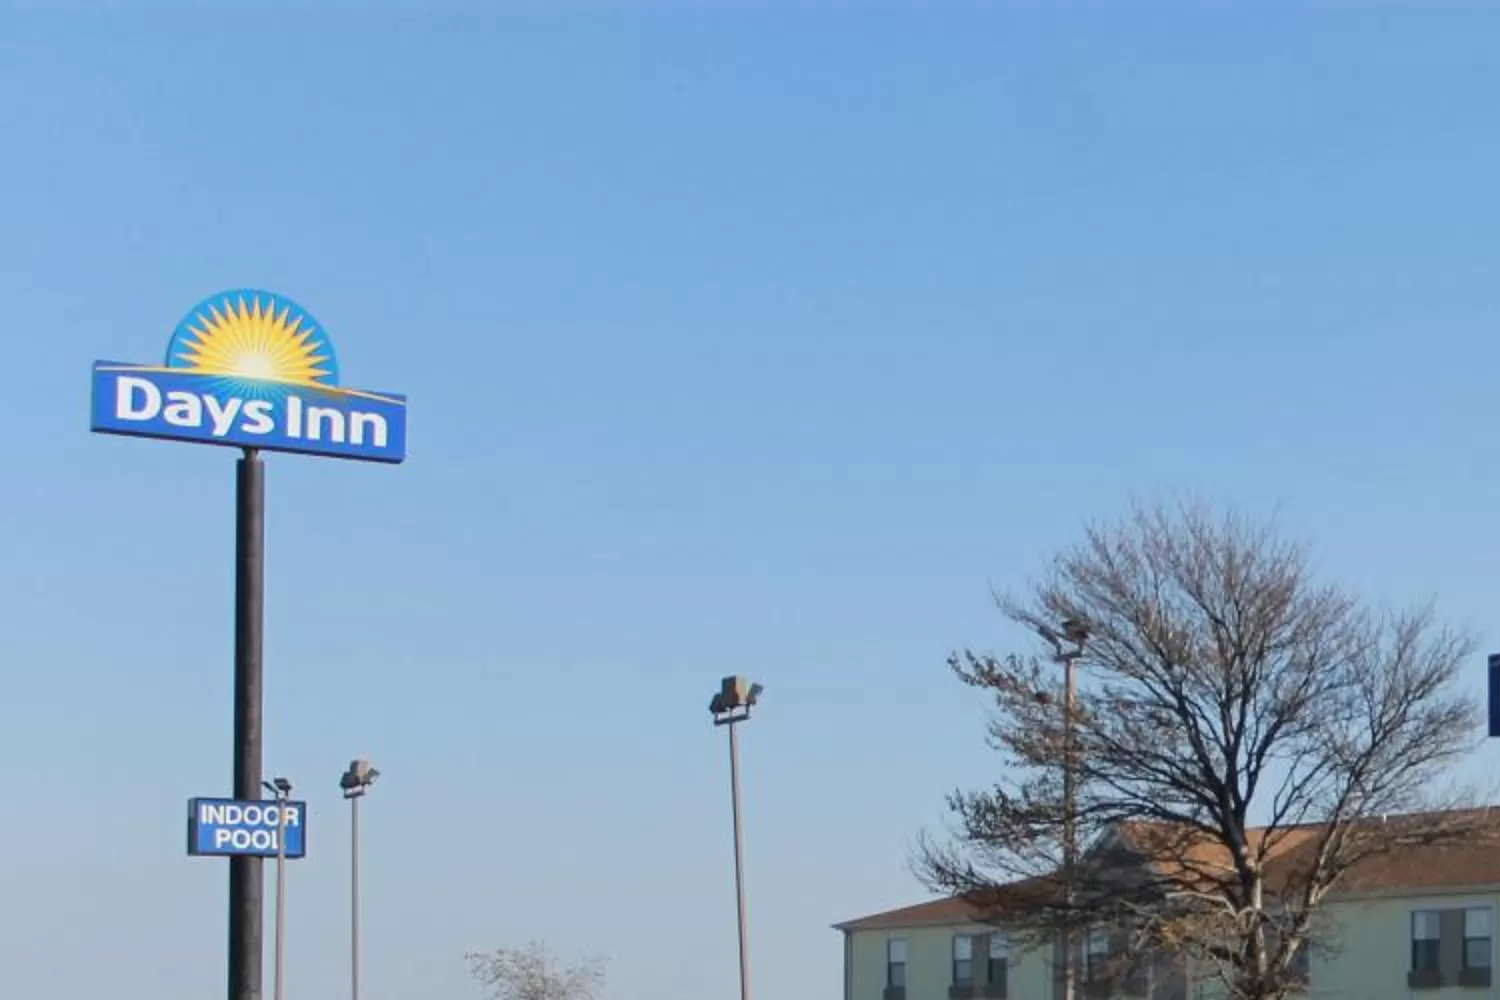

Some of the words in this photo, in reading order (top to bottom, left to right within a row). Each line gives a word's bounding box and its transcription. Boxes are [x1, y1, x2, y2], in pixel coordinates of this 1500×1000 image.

[115, 375, 275, 437] Days
[286, 395, 389, 448] Inn
[200, 804, 299, 827] INDOOR
